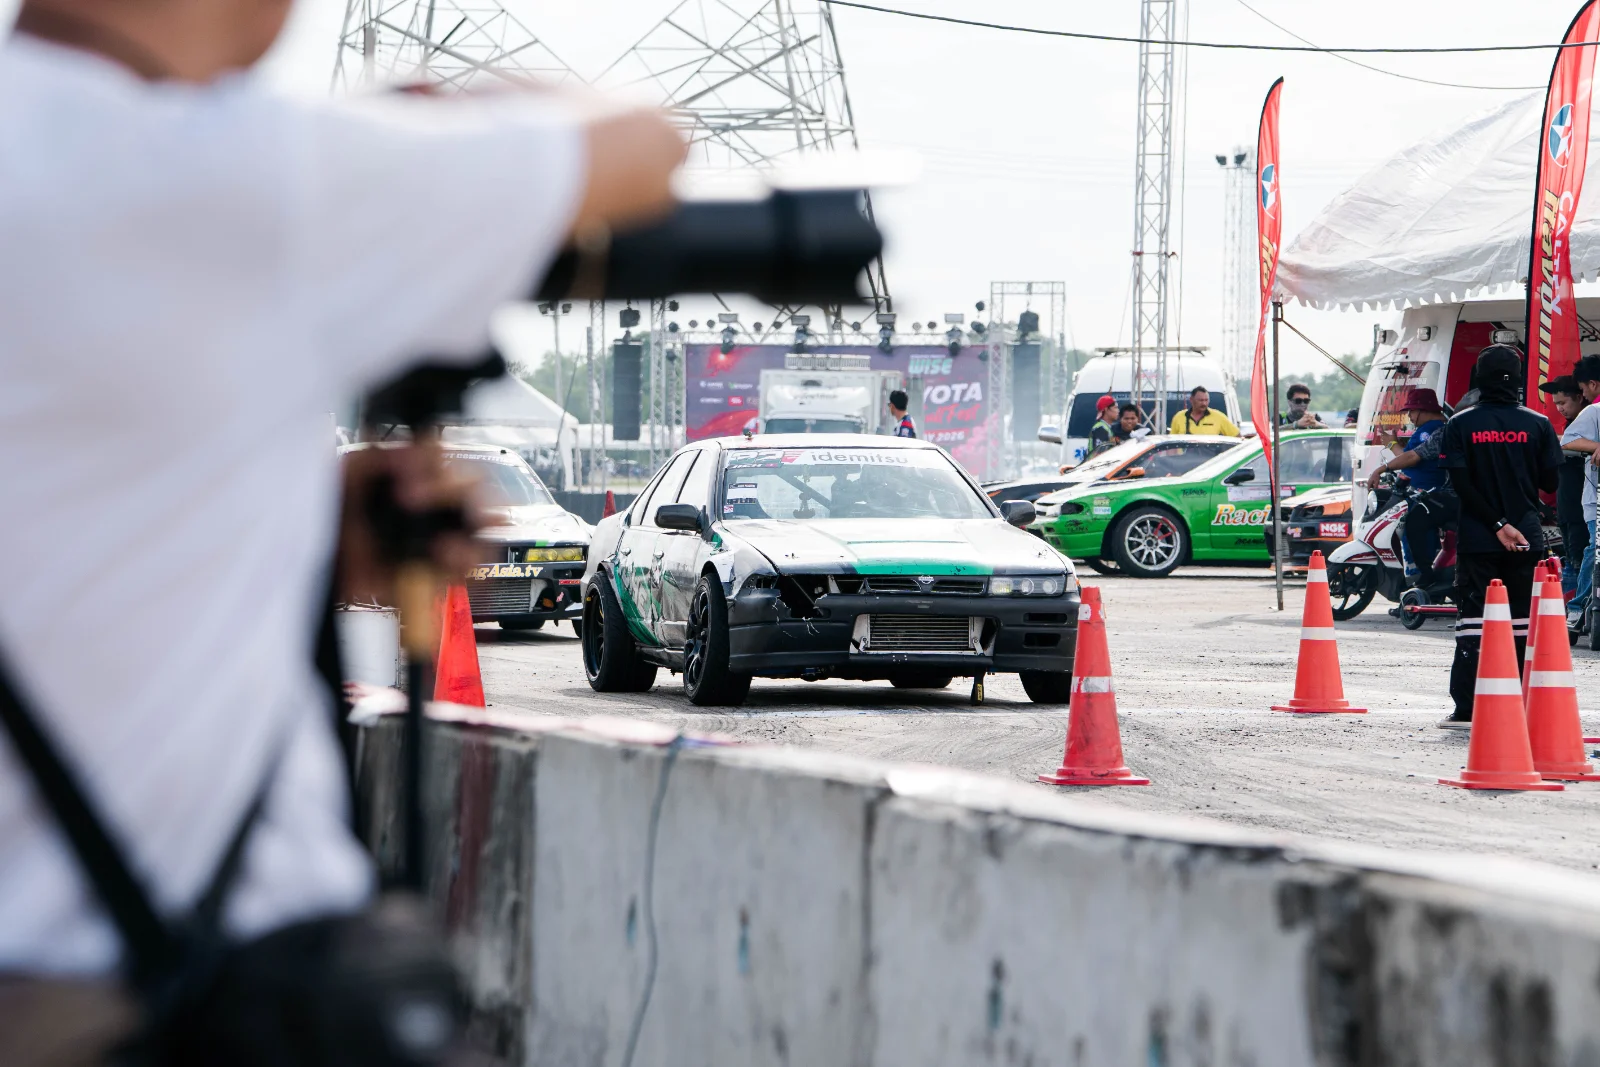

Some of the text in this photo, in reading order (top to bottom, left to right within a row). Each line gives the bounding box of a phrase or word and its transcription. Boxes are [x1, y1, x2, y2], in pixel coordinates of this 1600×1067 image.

[1472, 430, 1528, 444] HARSON
[811, 452, 908, 463] idemitsu
[1321, 523, 1346, 533] NGK
